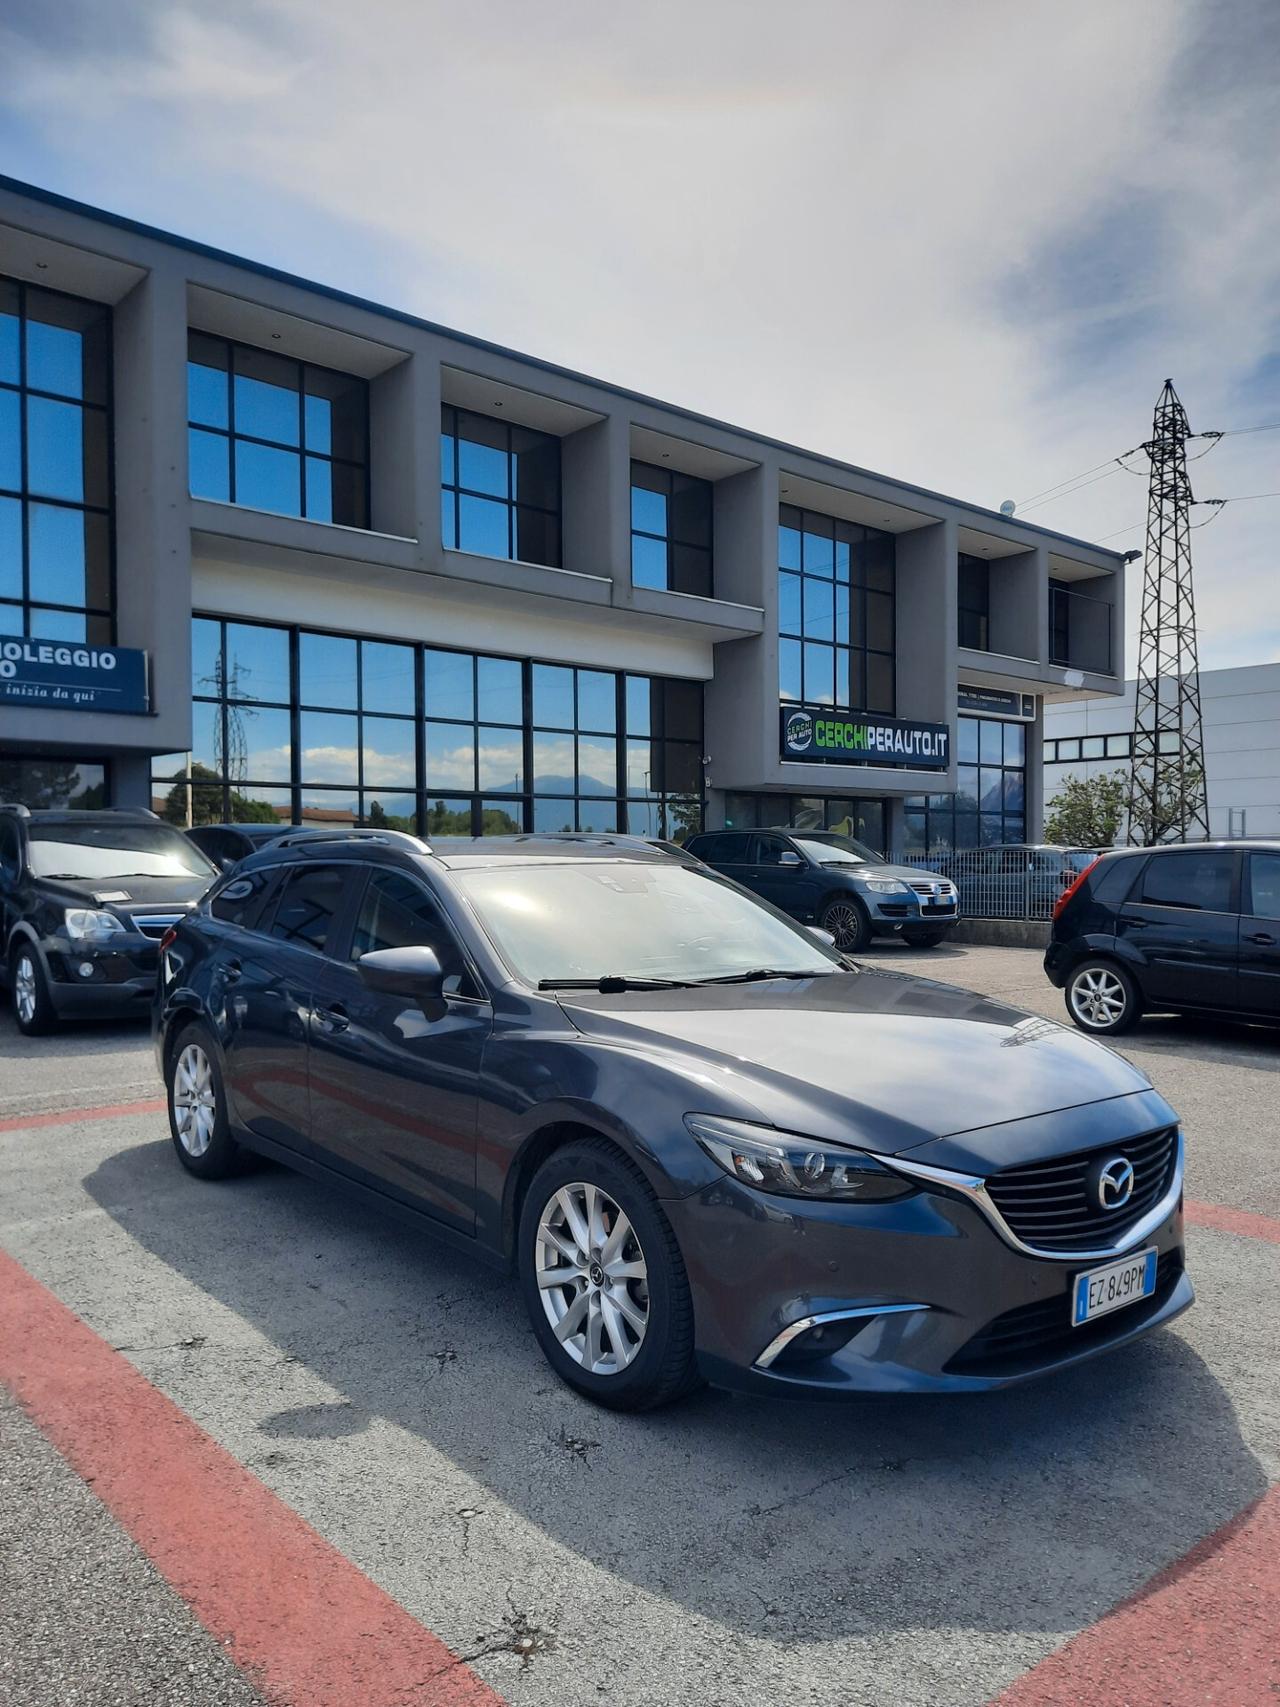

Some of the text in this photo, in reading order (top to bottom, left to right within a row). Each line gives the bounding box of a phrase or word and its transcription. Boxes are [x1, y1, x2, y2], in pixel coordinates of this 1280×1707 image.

[0, 641, 116, 670] OLEGGIO
[6, 683, 95, 703] inizia da qui
[787, 720, 813, 735] CERCHI
[787, 728, 813, 742] PER AUTO
[816, 720, 947, 756] CERCHIPERAUTO.IT
